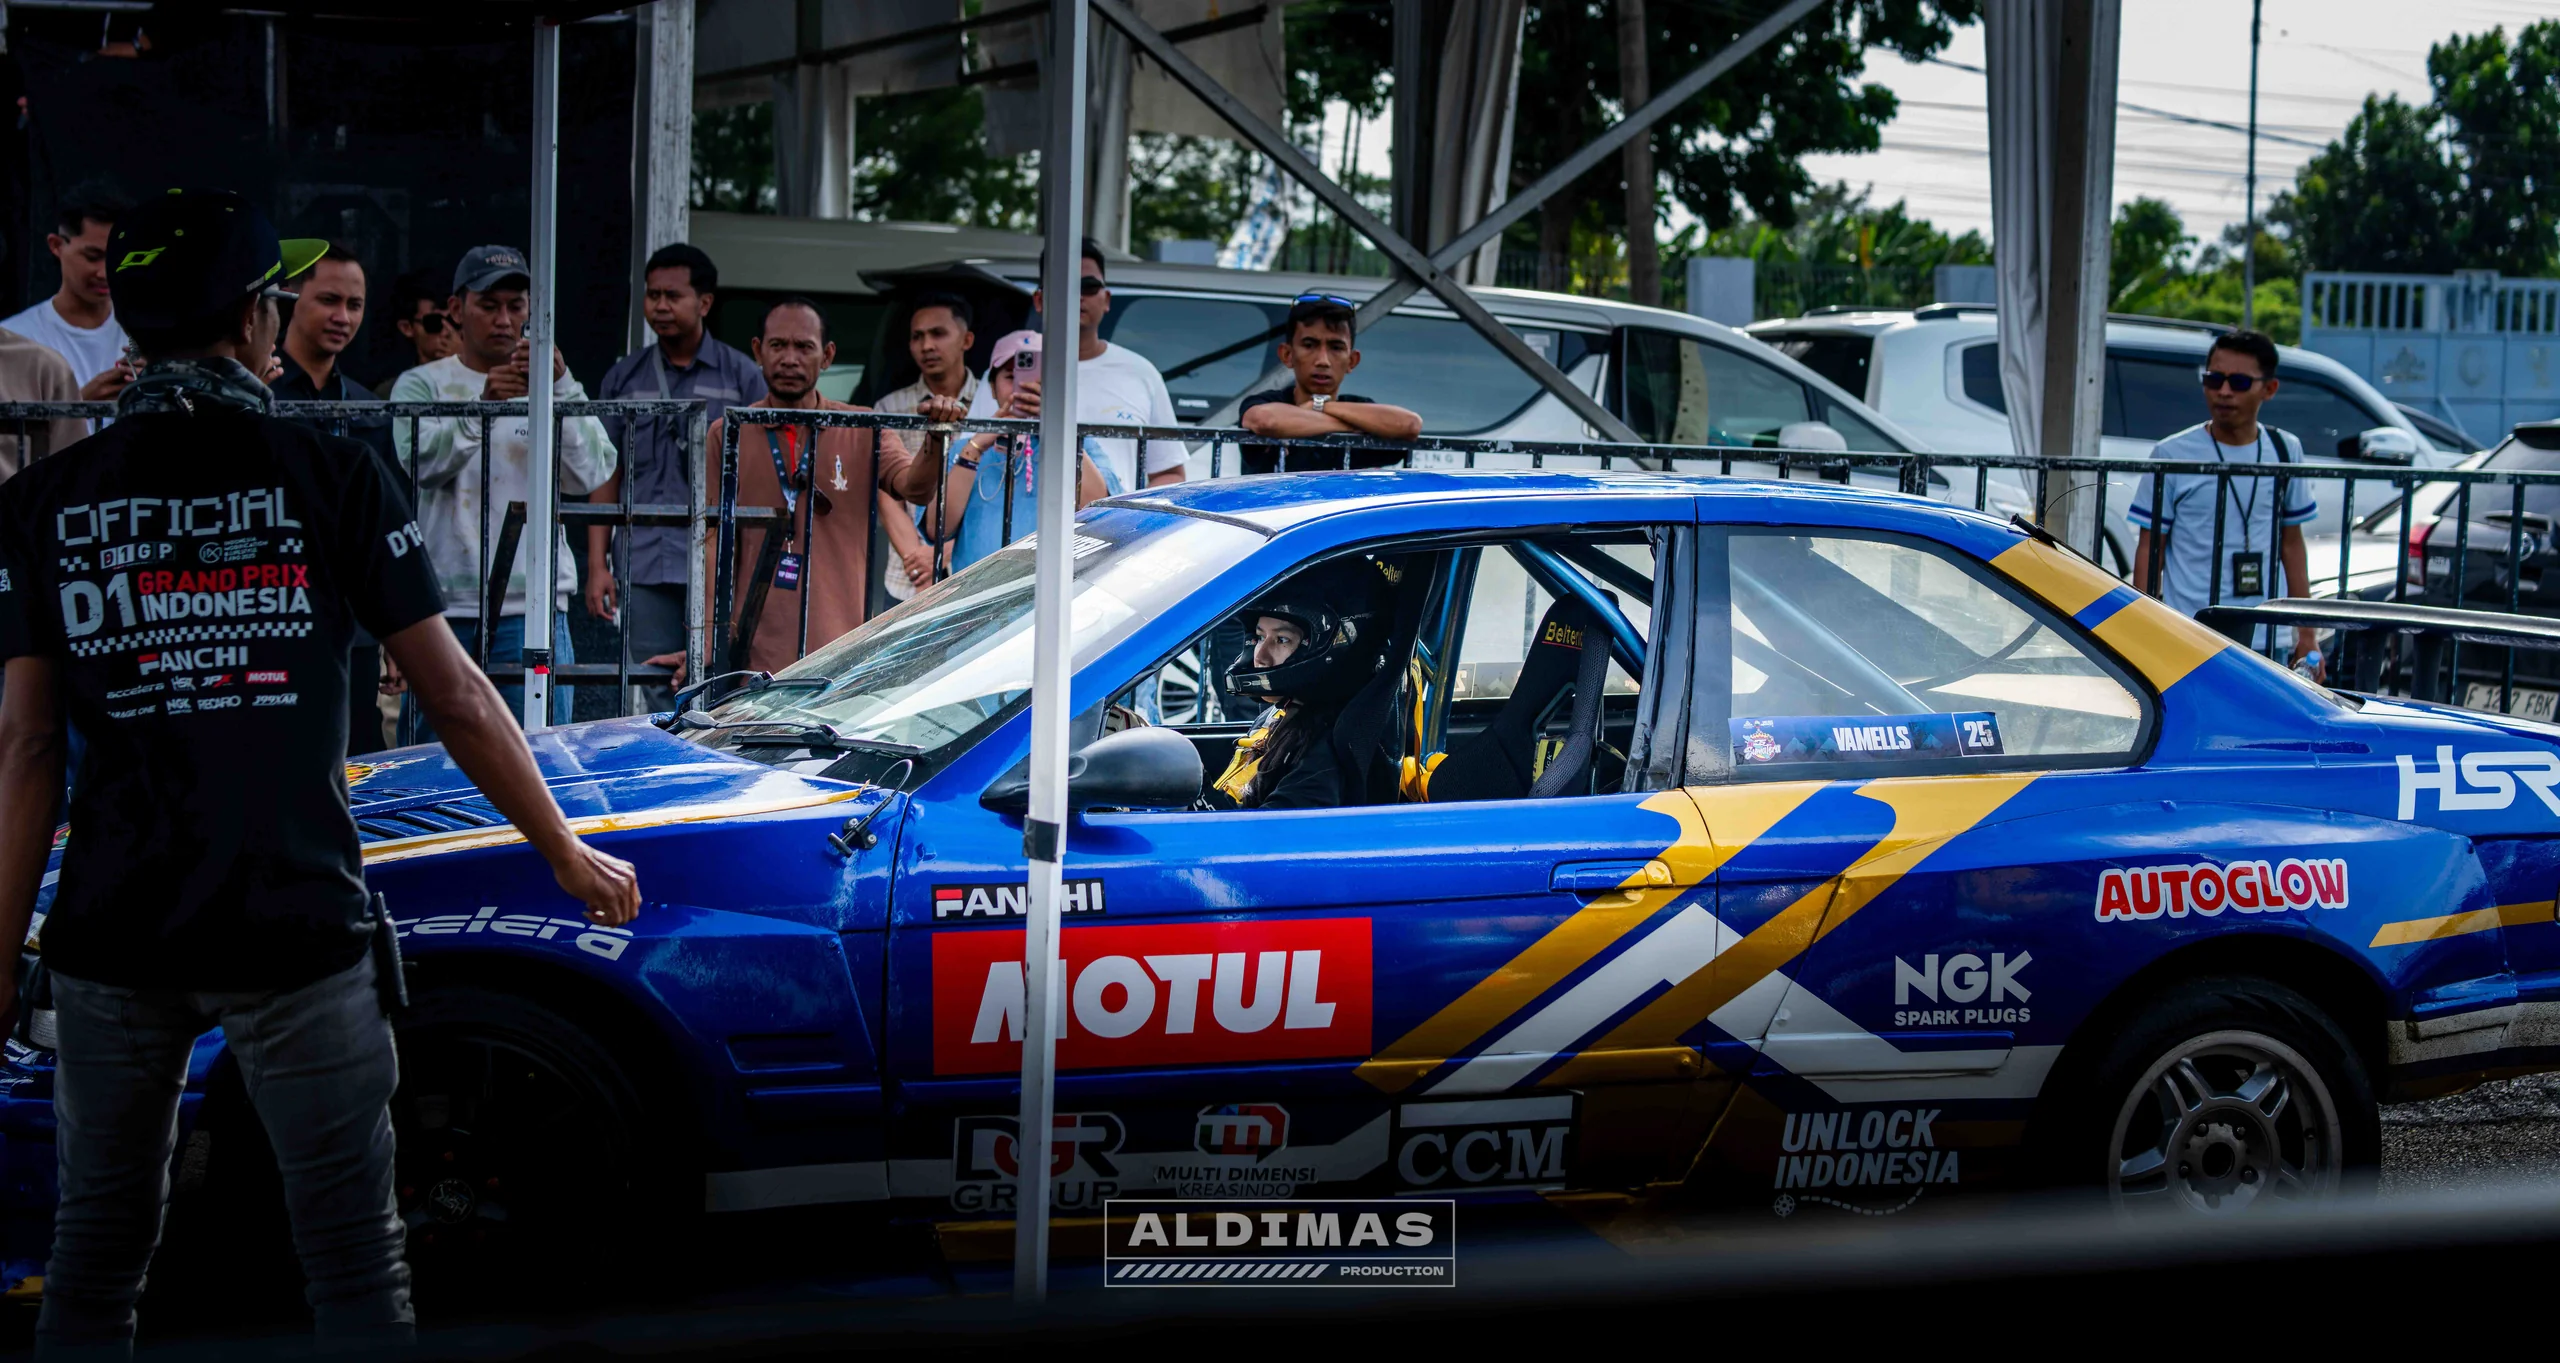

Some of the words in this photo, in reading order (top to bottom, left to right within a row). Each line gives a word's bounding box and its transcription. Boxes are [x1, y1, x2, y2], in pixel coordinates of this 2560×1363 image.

[57, 487, 302, 546] OFFICIAL
[138, 568, 236, 594] GRAND
[242, 564, 310, 589] PRIX
[59, 572, 137, 638] D1
[140, 586, 312, 622] INDONESIA
[137, 646, 249, 676] FANCHI
[247, 671, 287, 682] MOTUL
[107, 707, 138, 719] ARAGE
[166, 698, 192, 710] NGK
[2483, 687, 2520, 710] 127
[2524, 692, 2556, 716] FBK
[1832, 726, 1912, 751] VAMELLS
[1964, 720, 1994, 748] 25
[2396, 745, 2560, 820] HSR
[936, 882, 1103, 917] FANHI
[2098, 861, 2346, 919] AUTOGLOW
[1895, 950, 2033, 1005] NGK
[970, 949, 1337, 1044] MOTUL
[1894, 1010, 1959, 1026] SPARK
[1965, 1008, 2031, 1024] PLUGS
[1782, 1109, 1941, 1153] UNLOCK
[1158, 1167, 1221, 1182] MULTI
[1228, 1165, 1316, 1181] DIMENSI
[1398, 1127, 1570, 1185] CCM
[1774, 1151, 1959, 1189] INDONESIA
[955, 1181, 1119, 1211] GRUP
[1178, 1182, 1291, 1198] KREASINDO
